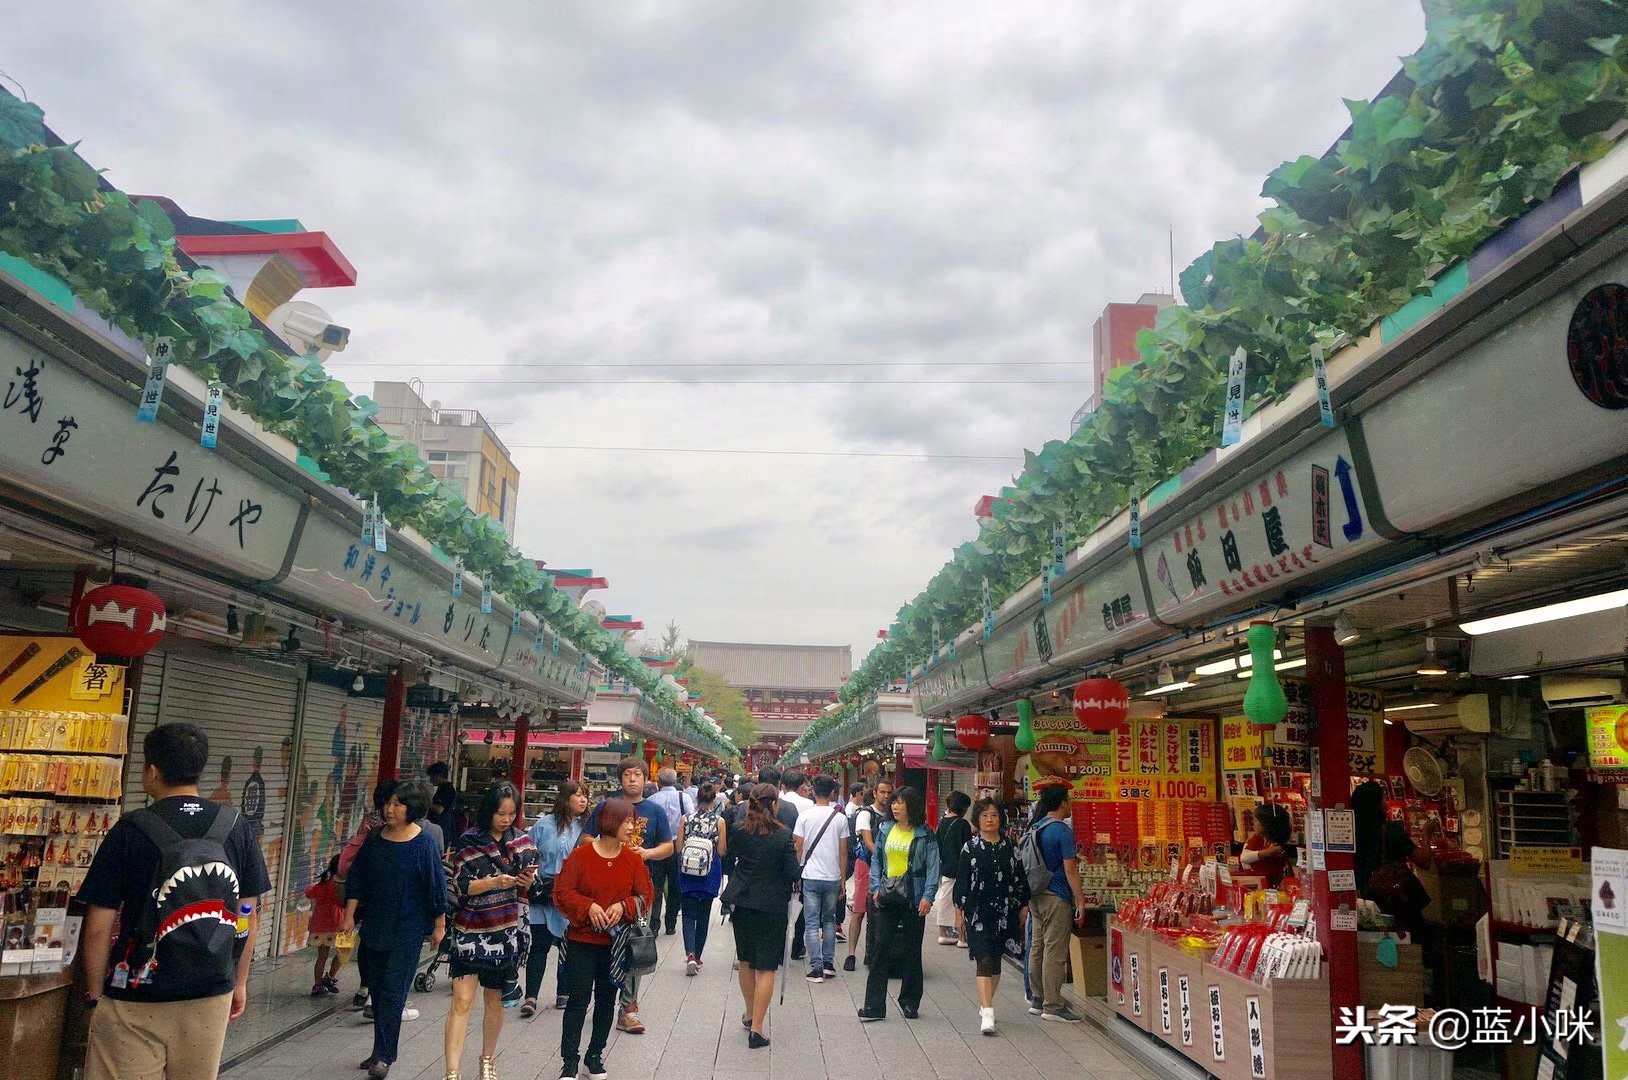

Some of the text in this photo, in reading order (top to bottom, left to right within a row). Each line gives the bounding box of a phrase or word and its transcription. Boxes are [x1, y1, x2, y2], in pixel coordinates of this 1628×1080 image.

[144, 342, 169, 404] 仲見世
[1227, 359, 1244, 426] 仲見世
[1314, 356, 1331, 413] 仲見世
[205, 387, 221, 435] 仲見世
[136, 450, 263, 550] たけや
[443, 602, 491, 650] もりた
[81, 662, 109, 691] 箸
[1034, 742, 1077, 754] Yummy
[1080, 765, 1110, 774] 200円
[1141, 764, 1159, 773] セット
[1167, 724, 1180, 773] おこげせん
[1120, 778, 1151, 786] よりどり
[1156, 780, 1207, 799] 1,000円
[1249, 1000, 1264, 1076] 人形焼
